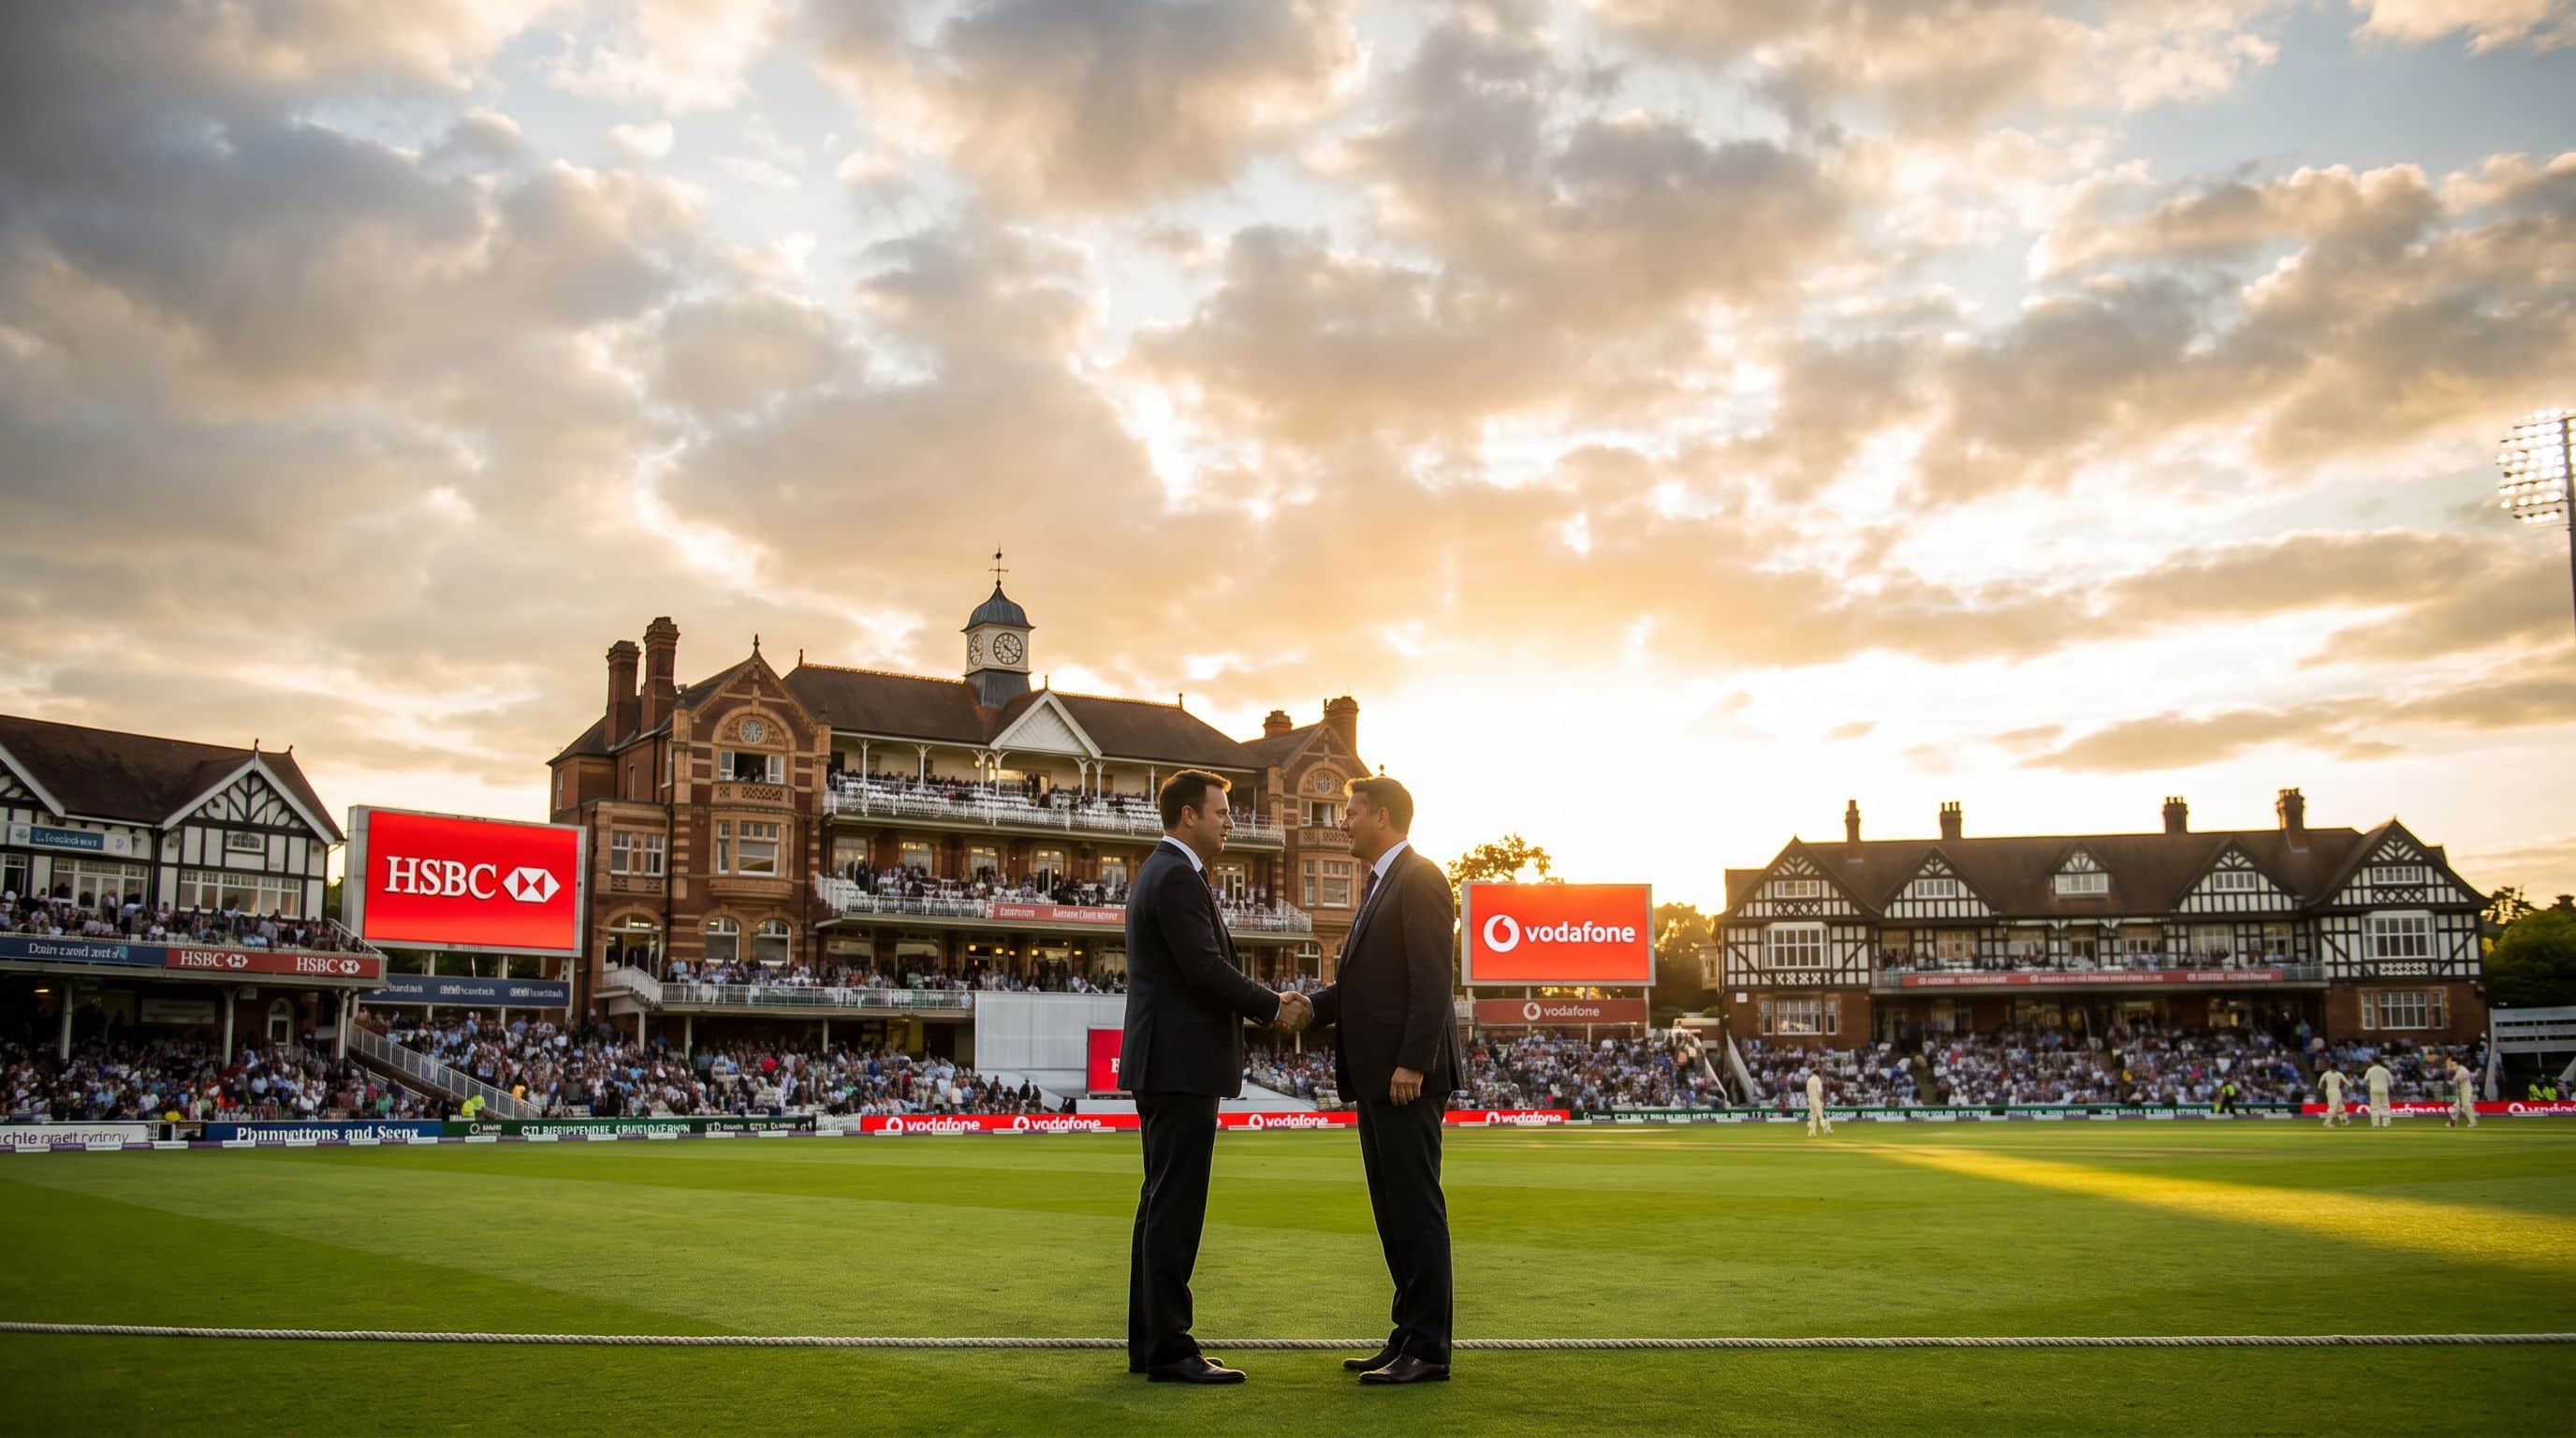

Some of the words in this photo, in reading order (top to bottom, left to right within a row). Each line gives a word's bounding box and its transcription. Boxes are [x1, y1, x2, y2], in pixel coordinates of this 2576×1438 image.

[385, 856, 497, 900] HSBC
[1525, 921, 1635, 943] vodafone
[180, 951, 225, 967] HSBC
[296, 957, 338, 973] HSBC
[1544, 1005, 1600, 1017] vodafone
[906, 1117, 980, 1132] vodafone
[1032, 1116, 1101, 1130] vodafone
[1266, 1114, 1328, 1127] vodafone
[344, 1125, 373, 1139] and
